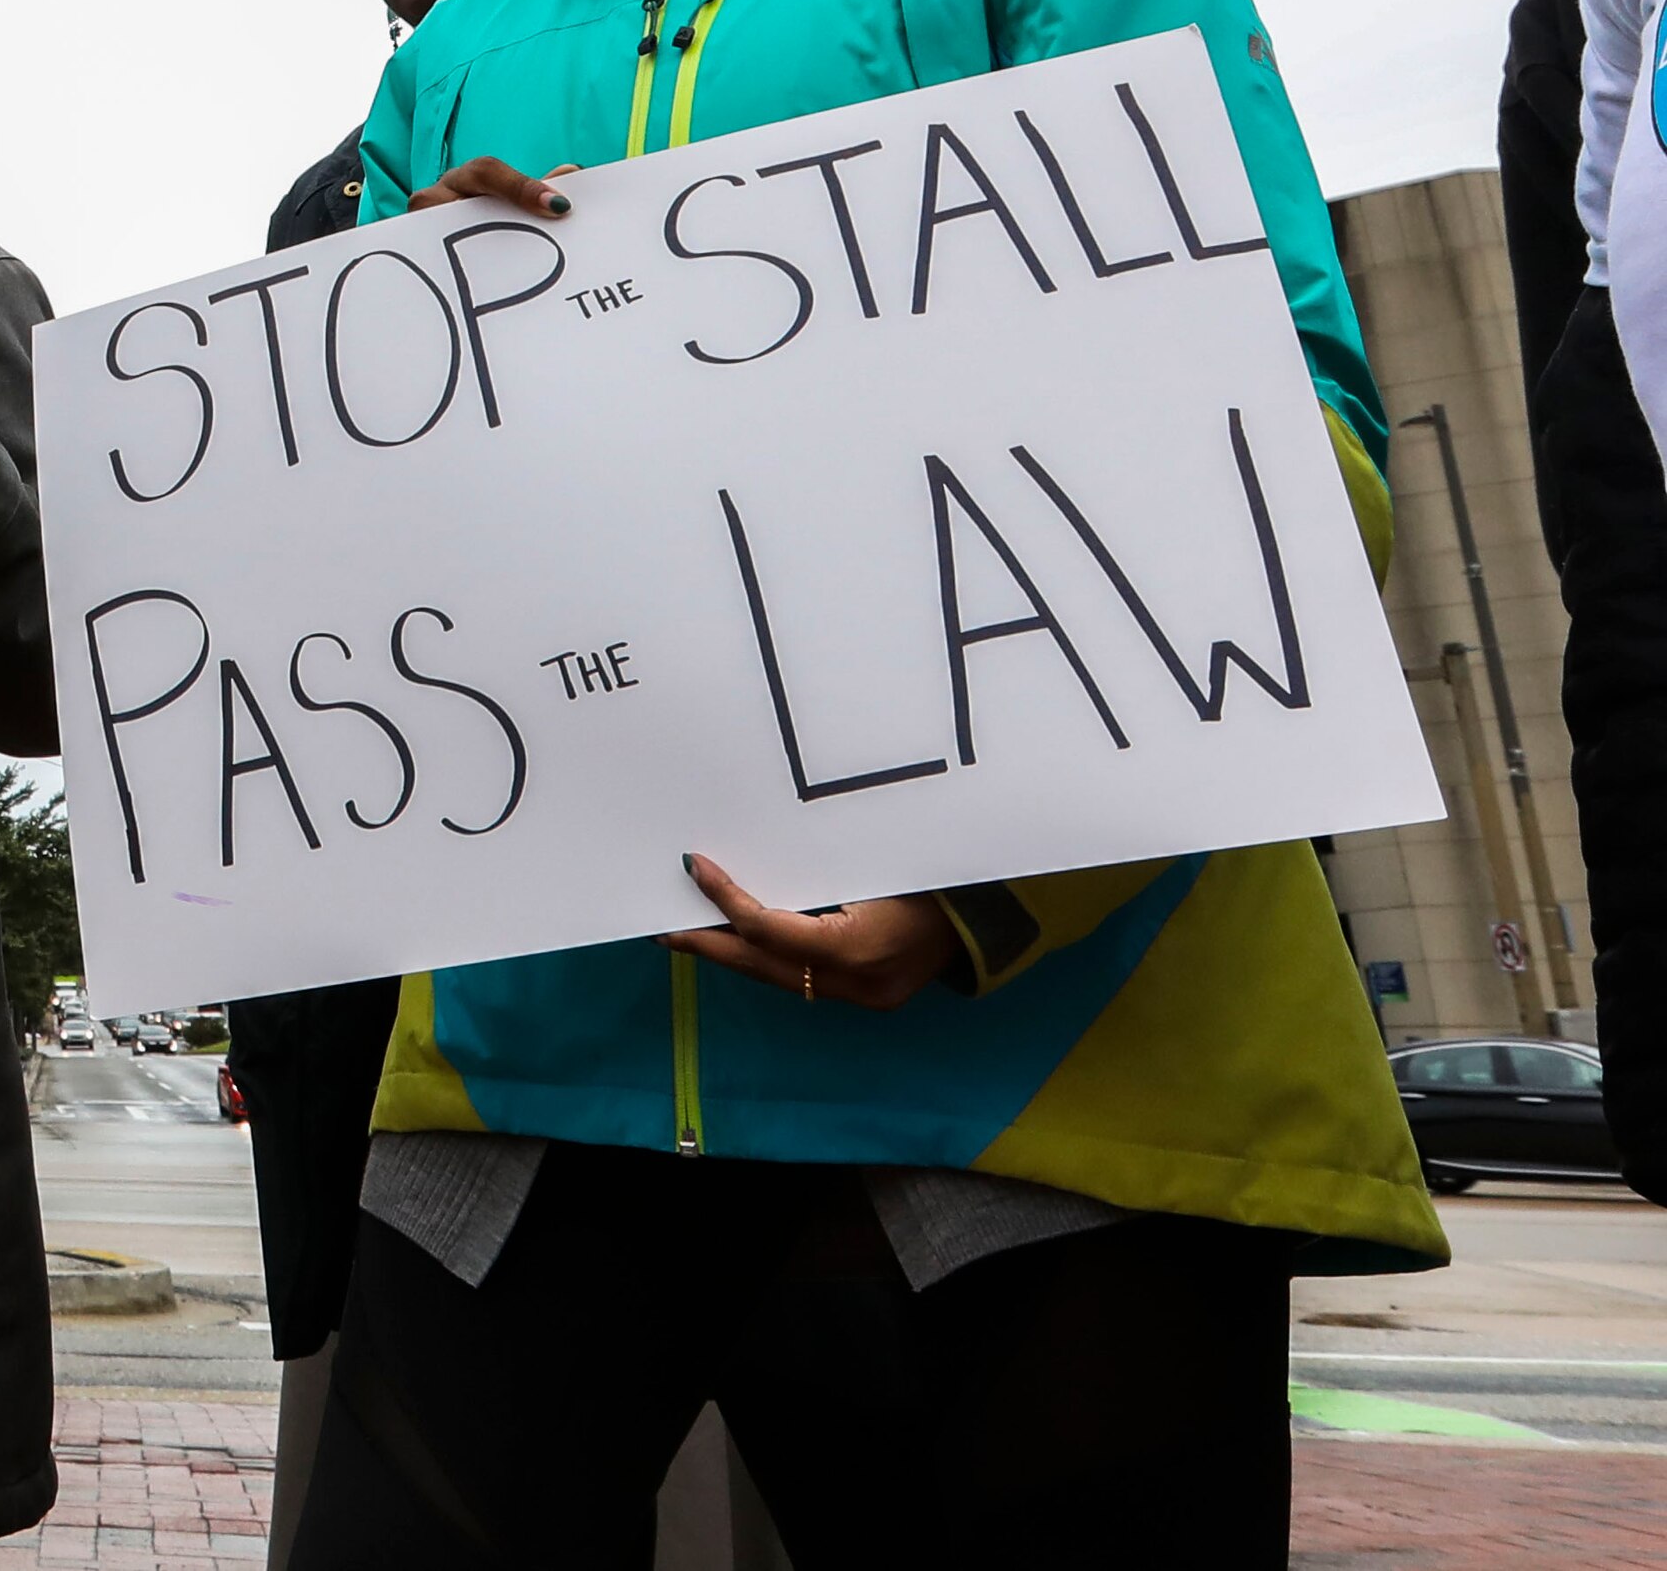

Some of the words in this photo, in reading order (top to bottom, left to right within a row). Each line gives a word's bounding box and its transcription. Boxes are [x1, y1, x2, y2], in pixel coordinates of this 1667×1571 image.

[106, 221, 566, 503] STOP
[566, 278, 644, 319] THE
[664, 82, 1268, 365] STALL
[84, 589, 527, 884] PASS
[539, 641, 640, 701] THE
[718, 408, 1312, 803] LAW
